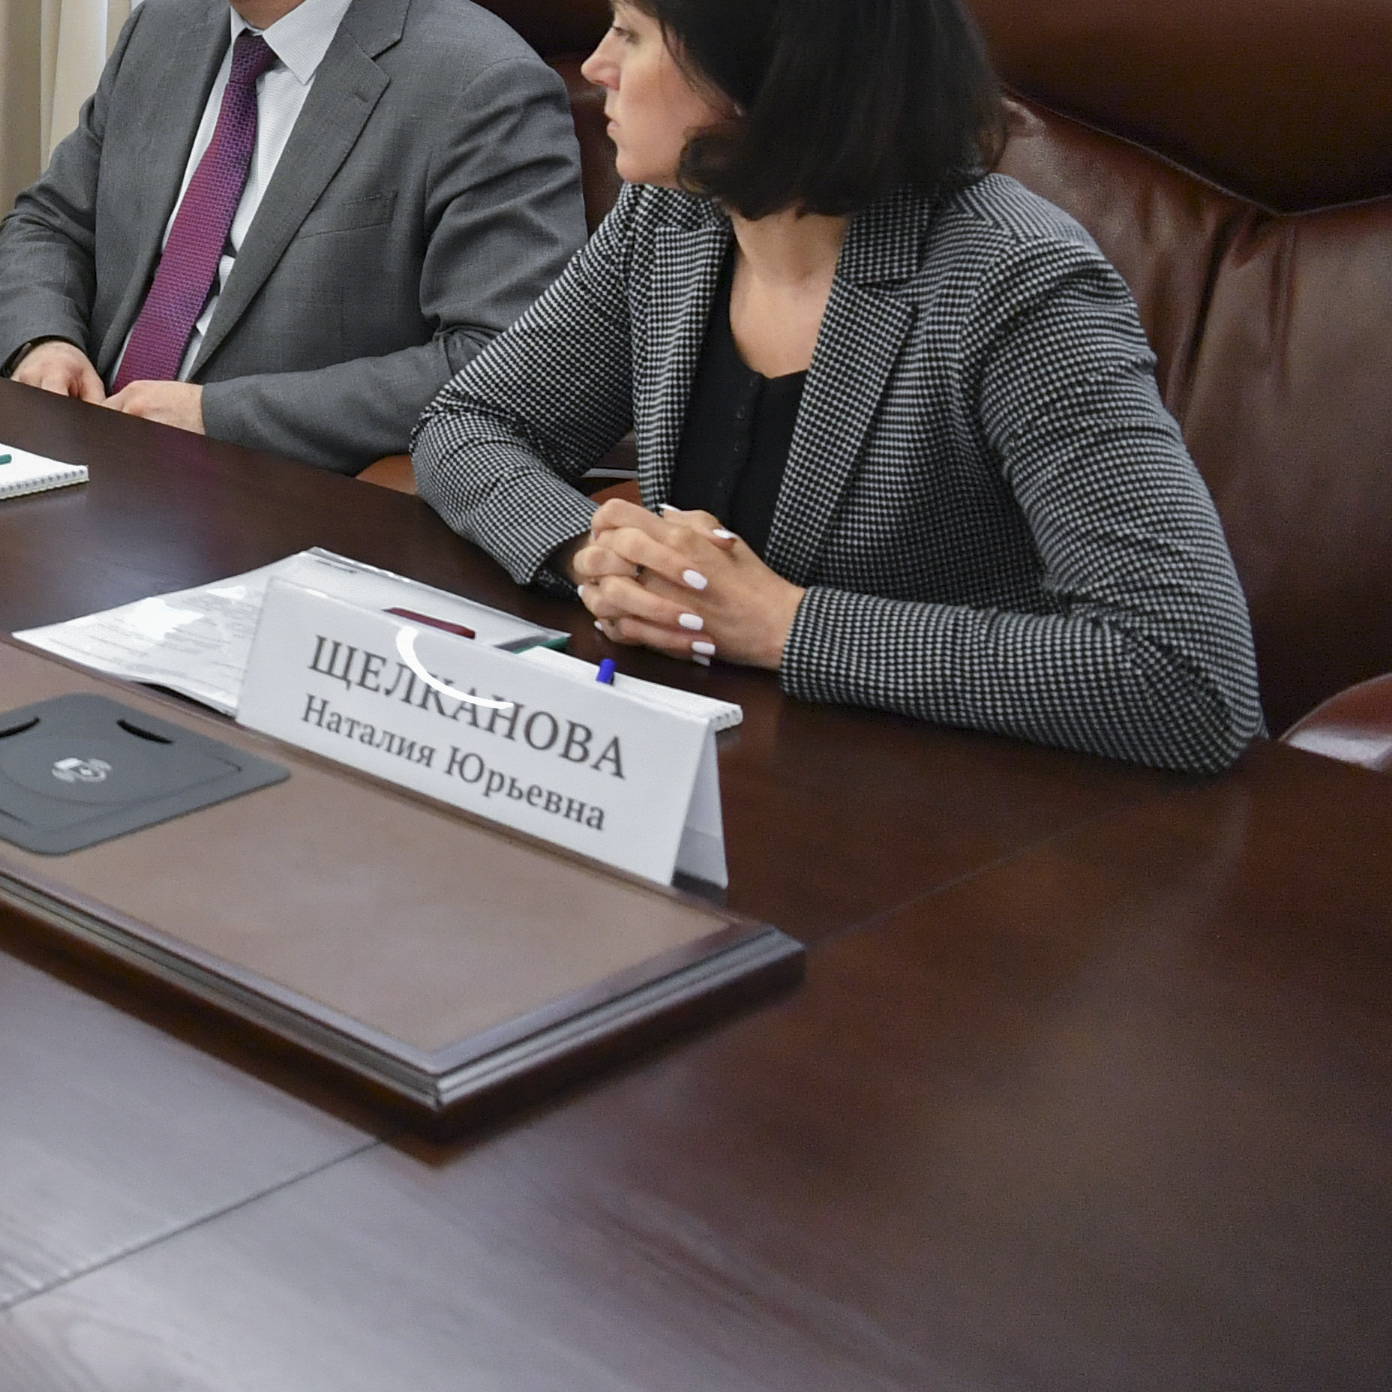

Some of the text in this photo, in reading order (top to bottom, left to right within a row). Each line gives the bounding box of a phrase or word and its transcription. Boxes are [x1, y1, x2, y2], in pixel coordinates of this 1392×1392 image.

[300, 693, 606, 832] Наталия Юрьевна
[308, 634, 626, 780] ЩЕЛКАНОВА
